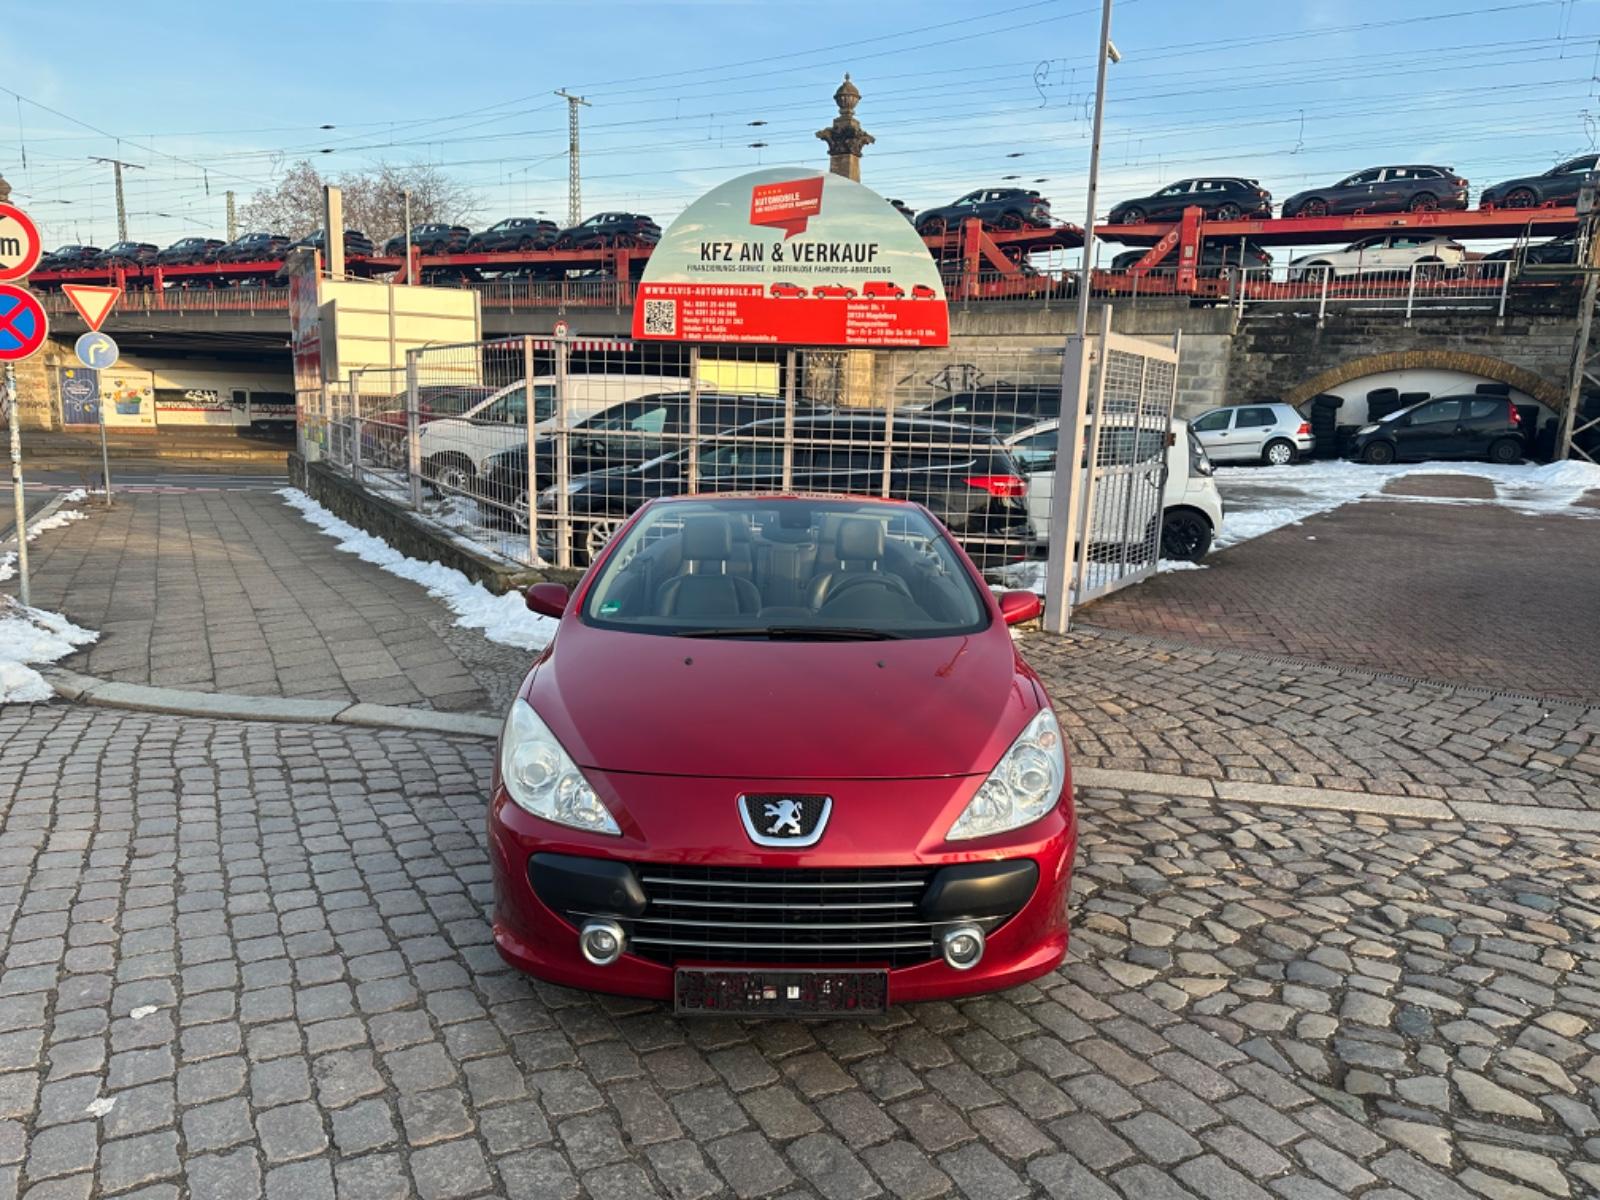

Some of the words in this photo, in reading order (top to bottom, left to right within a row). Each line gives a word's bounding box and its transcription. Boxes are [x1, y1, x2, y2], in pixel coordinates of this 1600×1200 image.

[701, 242, 733, 261] KFZ
[740, 242, 763, 261] AN
[771, 242, 783, 262] &
[792, 243, 879, 262] VERKAUF
[687, 264, 765, 272] FINANZIERUNGS-SERVICE
[645, 286, 762, 296] WWW.ELVIS-AUTOMOBILE.DE
